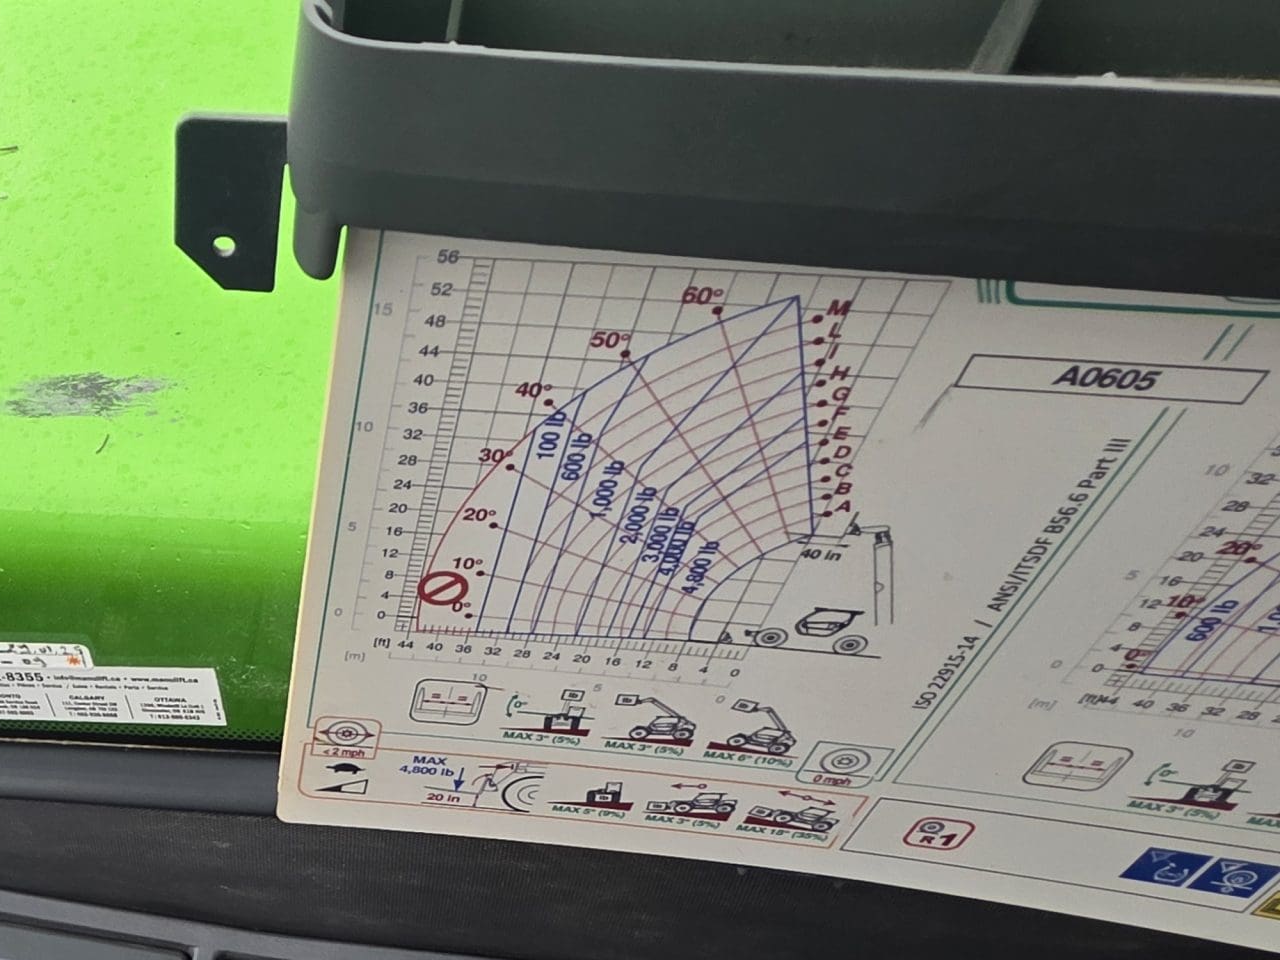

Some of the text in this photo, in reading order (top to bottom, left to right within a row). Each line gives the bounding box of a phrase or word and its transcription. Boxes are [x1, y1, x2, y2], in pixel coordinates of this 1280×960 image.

[437, 249, 460, 264] 56
[430, 283, 453, 296] 52
[682, 286, 724, 305] 60°
[374, 303, 393, 316] 15
[826, 299, 852, 316] M
[424, 315, 447, 328] 48
[828, 322, 842, 339] L
[590, 331, 631, 349] 50°
[418, 345, 440, 358] 44
[830, 365, 851, 380] H
[1052, 365, 1162, 392] A0605
[413, 374, 434, 387] 40
[515, 382, 553, 398] 40°
[831, 386, 852, 401] G
[408, 402, 428, 414] 36
[831, 406, 850, 421] F
[355, 421, 374, 432] 10
[832, 426, 851, 440] E
[403, 429, 423, 440] 32
[536, 411, 568, 460] 100 lb
[478, 448, 514, 463] 30°
[561, 432, 593, 481] 600 lb
[833, 445, 852, 459] D
[398, 454, 417, 466] 28
[835, 464, 853, 478] C
[393, 478, 412, 490] 24
[589, 460, 625, 520] 1,000 lb
[834, 482, 853, 495] B
[388, 503, 408, 514] 20
[835, 500, 852, 513] A
[463, 508, 497, 521] 20°
[619, 487, 658, 544] 2,000 lb
[386, 526, 403, 537] 16
[641, 507, 680, 563] 3,000 lb
[381, 548, 399, 558] 12
[800, 548, 842, 562] 40 in
[452, 557, 483, 570] 10°
[681, 540, 720, 594] 4,800 lb
[911, 690, 938, 710] ISO
[927, 634, 981, 690] 22915-14
[986, 536, 1053, 612] ANSI/ITSDF
[1077, 456, 1119, 489] Part
[1185, 600, 1240, 642] 600 lb
[397, 640, 414, 649] 44
[426, 642, 443, 652] 40
[455, 644, 472, 654] 36
[484, 647, 503, 656] 32
[513, 649, 532, 658] 28
[542, 651, 561, 661] 24
[572, 654, 591, 664] 20
[604, 657, 622, 667] 16
[635, 660, 652, 669] 12
[502, 731, 534, 741] MAX
[604, 740, 637, 750] MAX
[412, 756, 448, 766] MAX
[703, 750, 735, 761] MAX
[399, 765, 455, 777] 4,800 lb
[426, 793, 461, 802] 20 in
[552, 804, 581, 814] MAX
[1127, 799, 1165, 812] MAX
[645, 814, 677, 824] MAX
[736, 824, 767, 834] MAX
[920, 836, 935, 845] R
